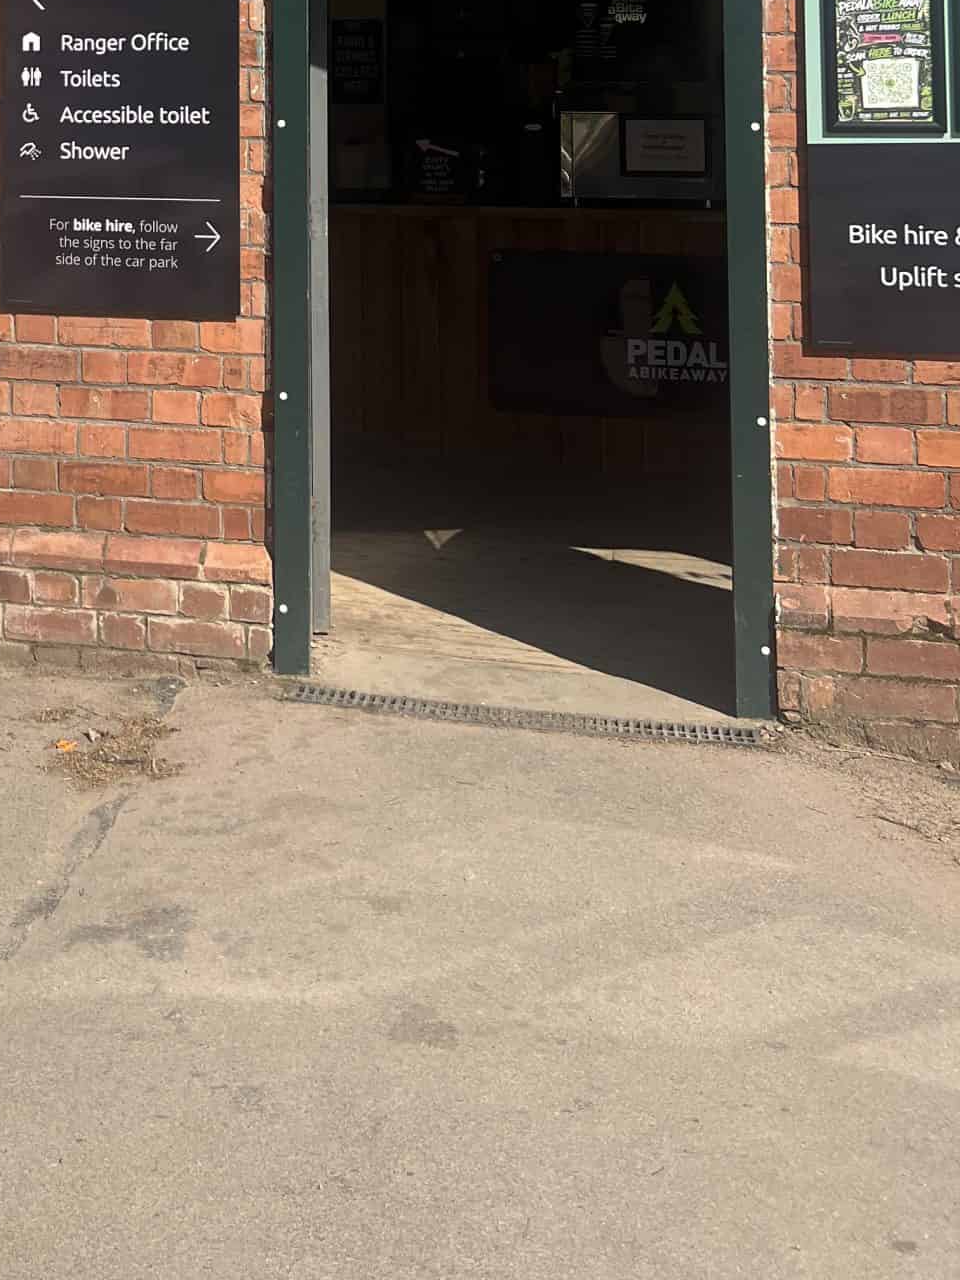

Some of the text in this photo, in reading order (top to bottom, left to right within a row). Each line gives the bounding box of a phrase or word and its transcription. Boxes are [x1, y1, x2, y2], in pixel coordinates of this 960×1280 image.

[881, 10, 916, 22] LUNCH
[62, 33, 189, 54] Ranger Office
[61, 69, 120, 87] Toilets
[60, 105, 209, 124] Accessible toilet
[61, 141, 129, 160] Shower
[50, 219, 177, 233] For bike hire, follow
[850, 224, 897, 244] Bike
[905, 224, 948, 245] hire
[60, 236, 177, 251] the signs to the far
[56, 253, 177, 270] side of the car park
[881, 266, 947, 290] Uplift
[626, 337, 728, 368] PEDAL
[628, 364, 729, 382] ABIKEAWAY
